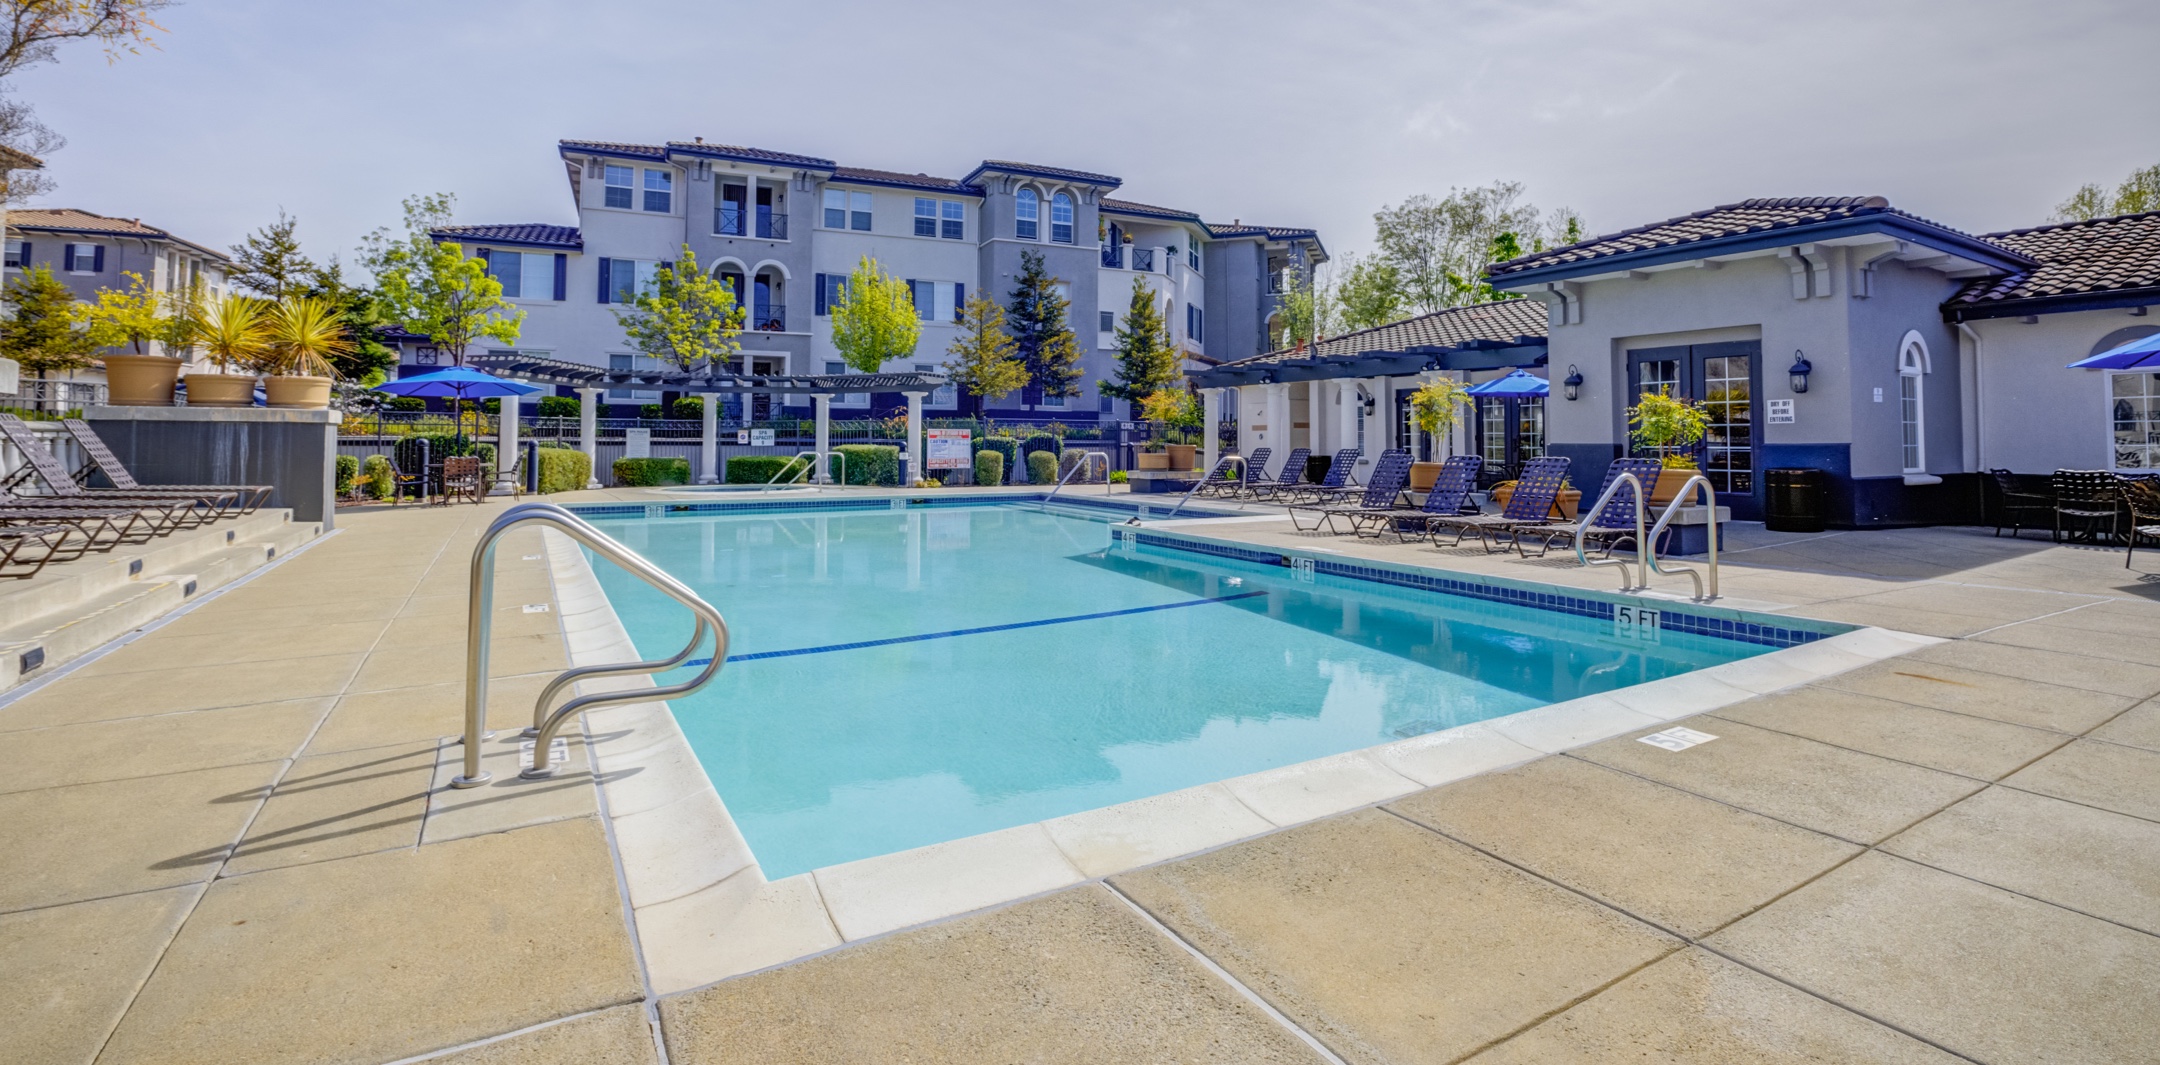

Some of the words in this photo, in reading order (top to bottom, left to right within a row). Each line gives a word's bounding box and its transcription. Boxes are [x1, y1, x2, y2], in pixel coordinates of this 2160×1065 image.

[1303, 559, 1314, 572] FT
[1619, 606, 1632, 624] 5
[1639, 609, 1658, 628] FT
